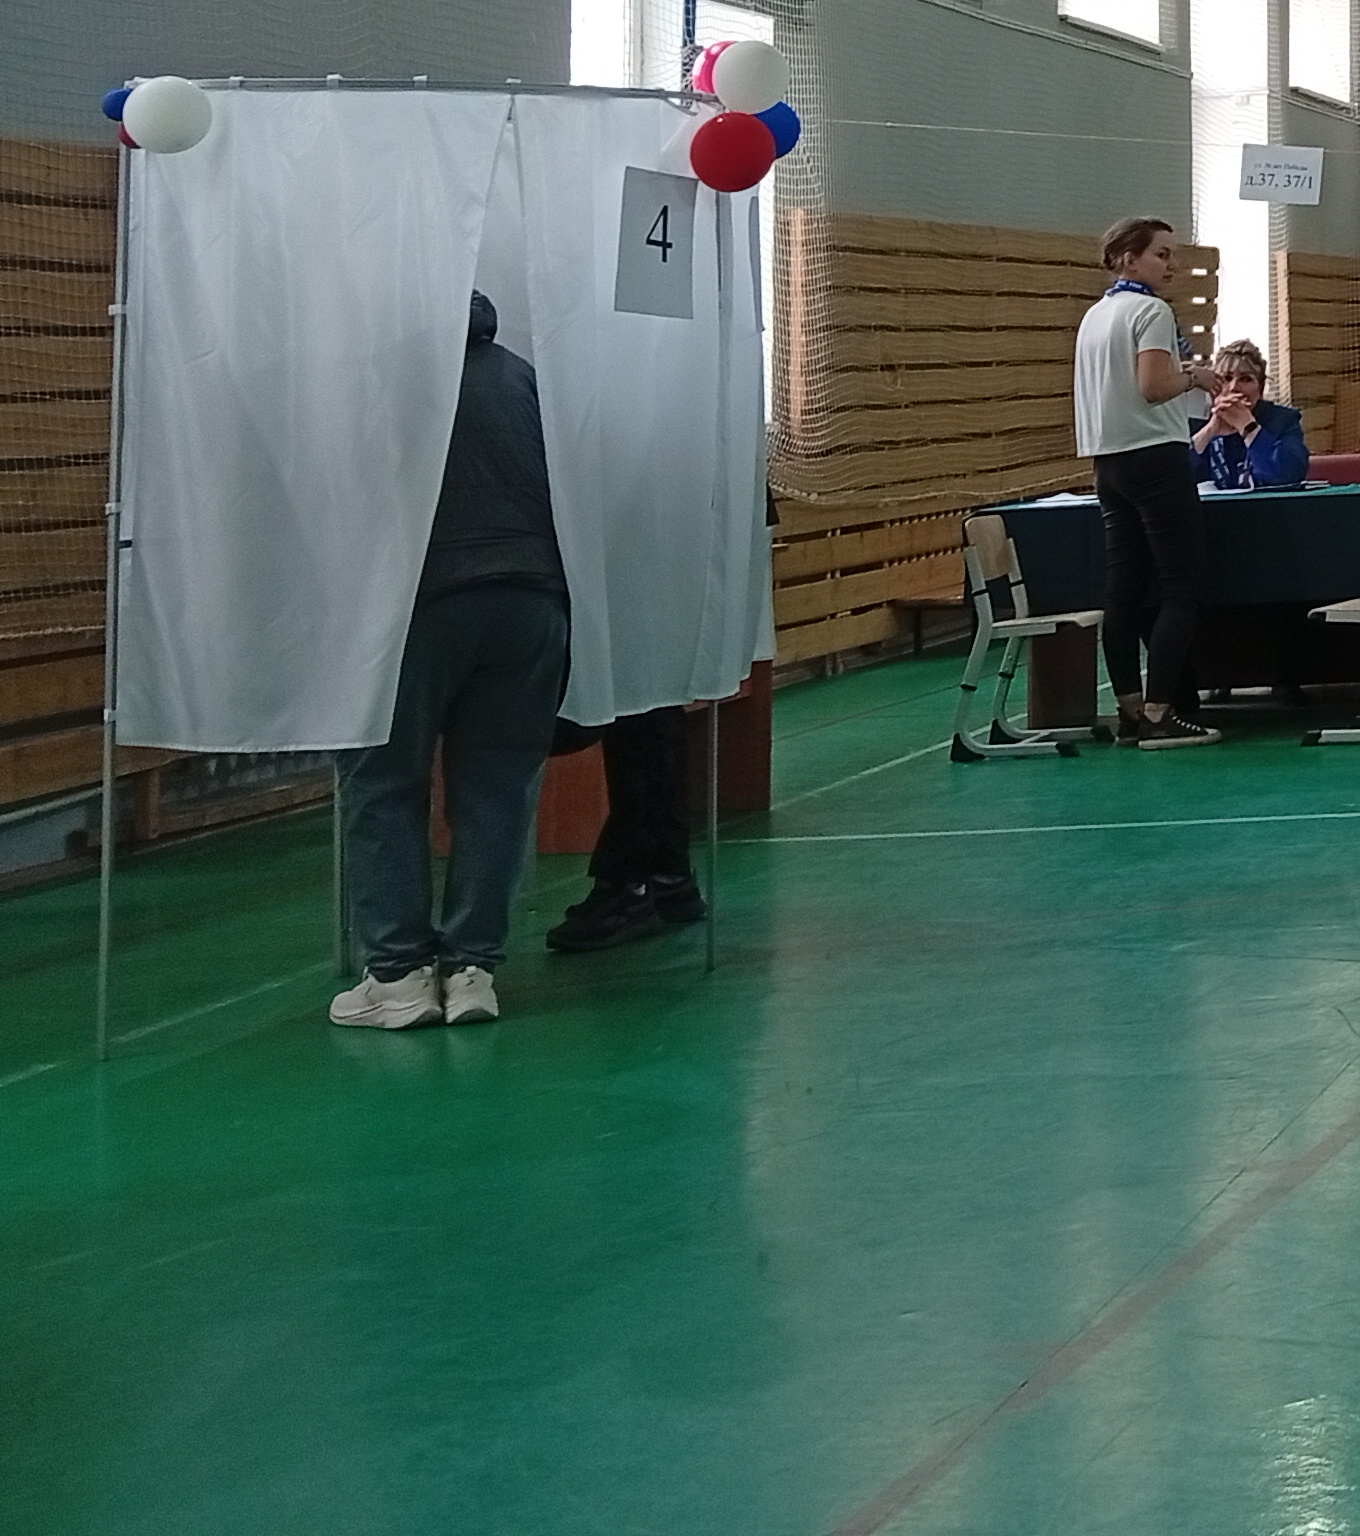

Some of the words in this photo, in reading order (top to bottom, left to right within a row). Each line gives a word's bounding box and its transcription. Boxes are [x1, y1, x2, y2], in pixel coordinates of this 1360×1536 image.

[1244, 172, 1279, 188] д.37,
[1283, 174, 1313, 189] 37/1
[646, 205, 673, 263] 4
